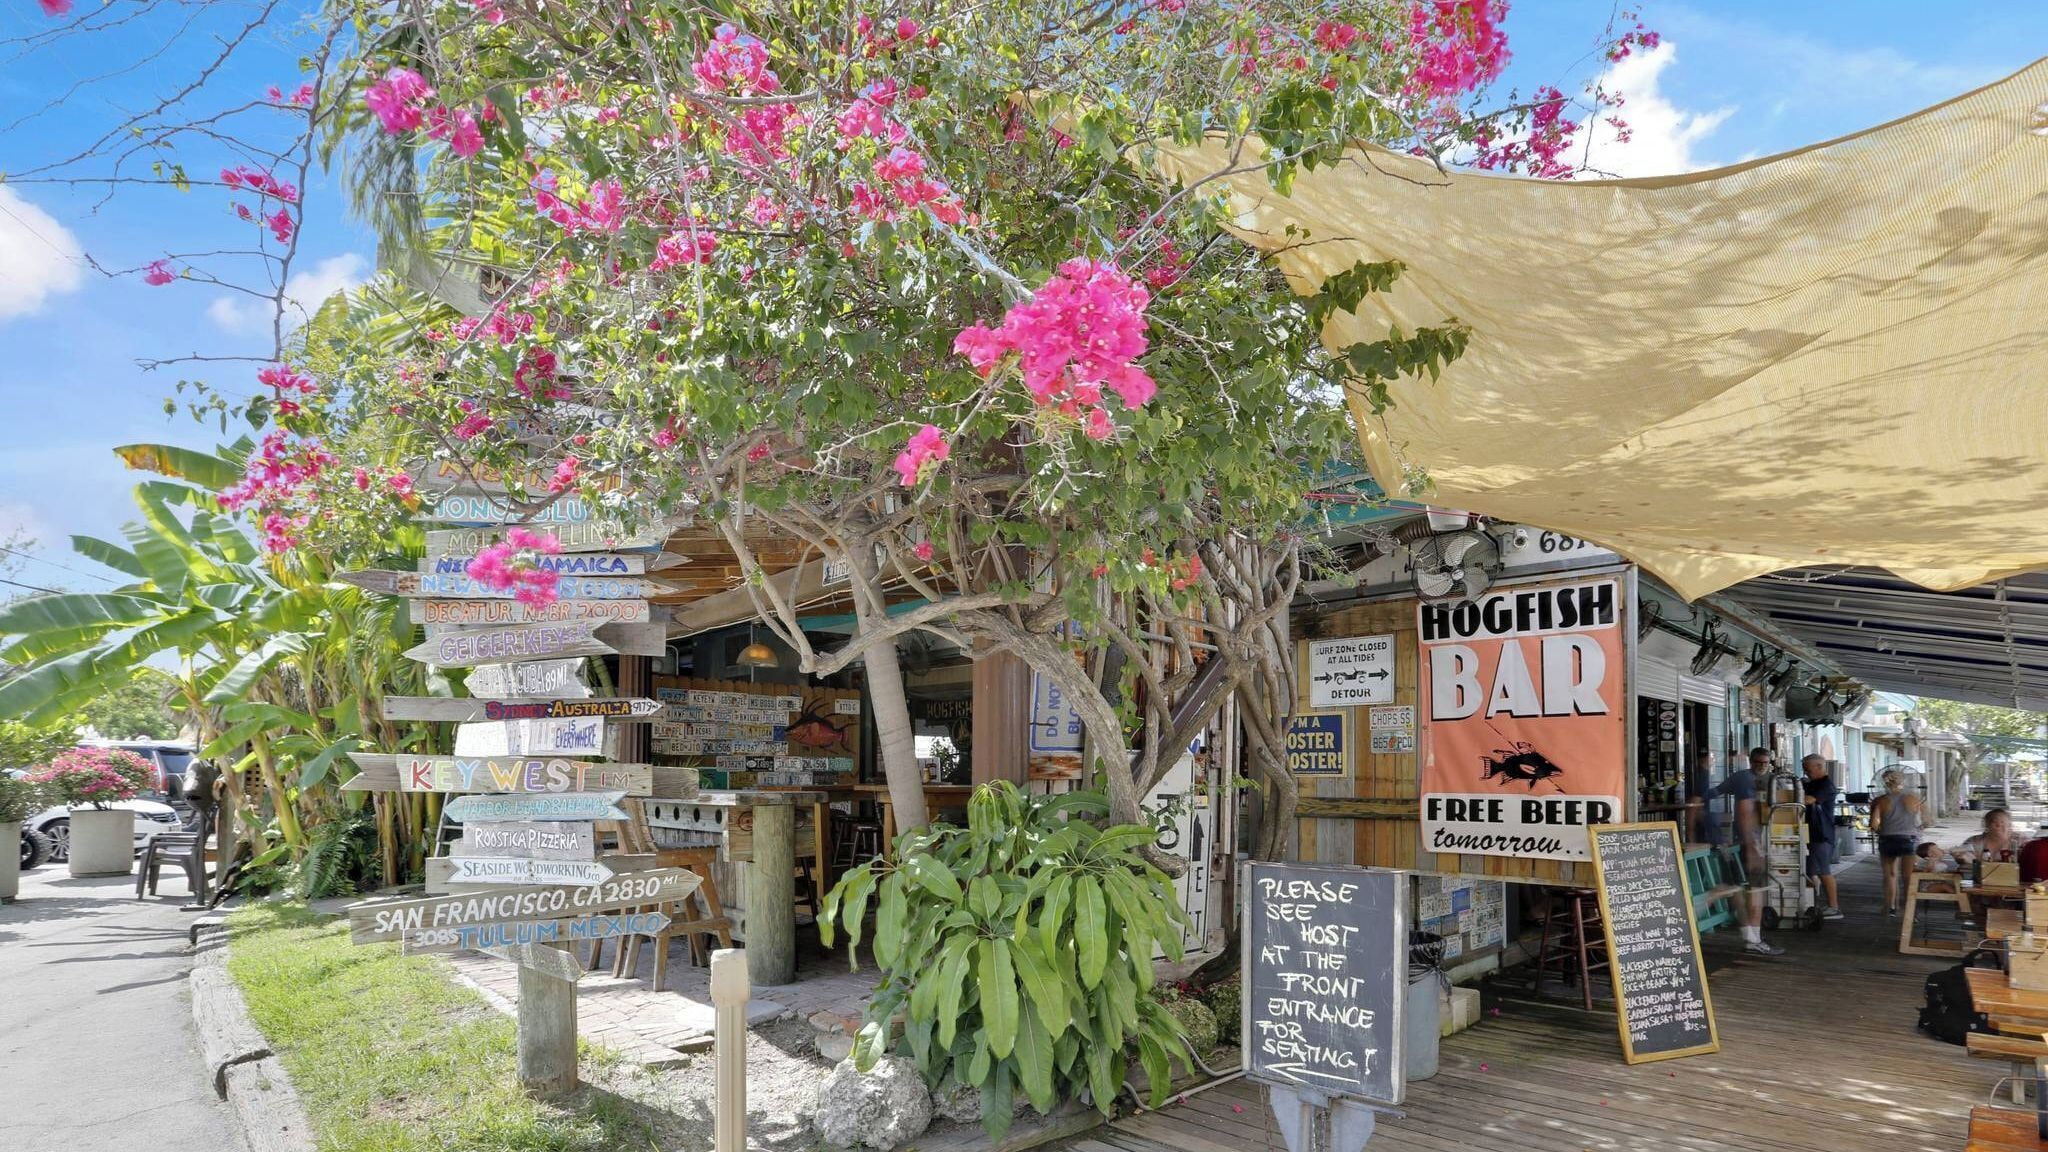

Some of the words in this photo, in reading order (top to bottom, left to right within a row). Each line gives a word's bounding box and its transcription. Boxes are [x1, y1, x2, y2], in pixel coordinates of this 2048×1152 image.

[535, 557, 628, 574] JAMAICA
[421, 575, 478, 594] NEW
[1421, 584, 1615, 641] HOGFISH
[440, 631, 518, 662] GEIGER
[523, 627, 565, 653] KEY
[1336, 644, 1357, 654] ZONE
[1358, 641, 1388, 653] CLOSED
[1327, 656, 1338, 665] AT
[1339, 655, 1352, 664] ALL
[1353, 653, 1376, 662] TIDES
[517, 664, 545, 693] CUBA
[1429, 634, 1610, 721] BAR
[1331, 688, 1371, 699] DETOUR
[552, 700, 631, 717] AUSTRALIA
[568, 719, 577, 732] IS
[1046, 715, 1059, 738] DO
[1312, 717, 1320, 728] A
[555, 724, 597, 749] EVERYWHERE
[410, 760, 480, 791] KEY
[488, 759, 594, 792] WEST
[1427, 798, 1504, 823] FREE
[1521, 799, 1612, 826] BEER
[475, 827, 527, 849] ROOSTICA
[528, 829, 579, 850] PIZZERIA
[463, 861, 512, 878] SEASIDE
[513, 861, 591, 880] WOODWORKING
[1257, 877, 1360, 903] PLEASE
[374, 908, 424, 935] SAN
[432, 888, 570, 928] FRANCISCO,
[573, 886, 602, 908] CA
[604, 877, 661, 903] 2830
[662, 875, 679, 886] MI
[1266, 903, 1317, 922] SEE
[415, 929, 459, 949] 3085
[458, 919, 559, 950] TULUM
[570, 914, 663, 941] MEXICO
[1300, 920, 1359, 948] HOST
[1261, 945, 1290, 966] AT
[1300, 951, 1347, 971] THE
[1277, 973, 1365, 1001] FRONT
[1645, 976, 1669, 990] BEANS
[1268, 997, 1375, 1029] ENTRANCE
[1255, 1020, 1306, 1043] FOR
